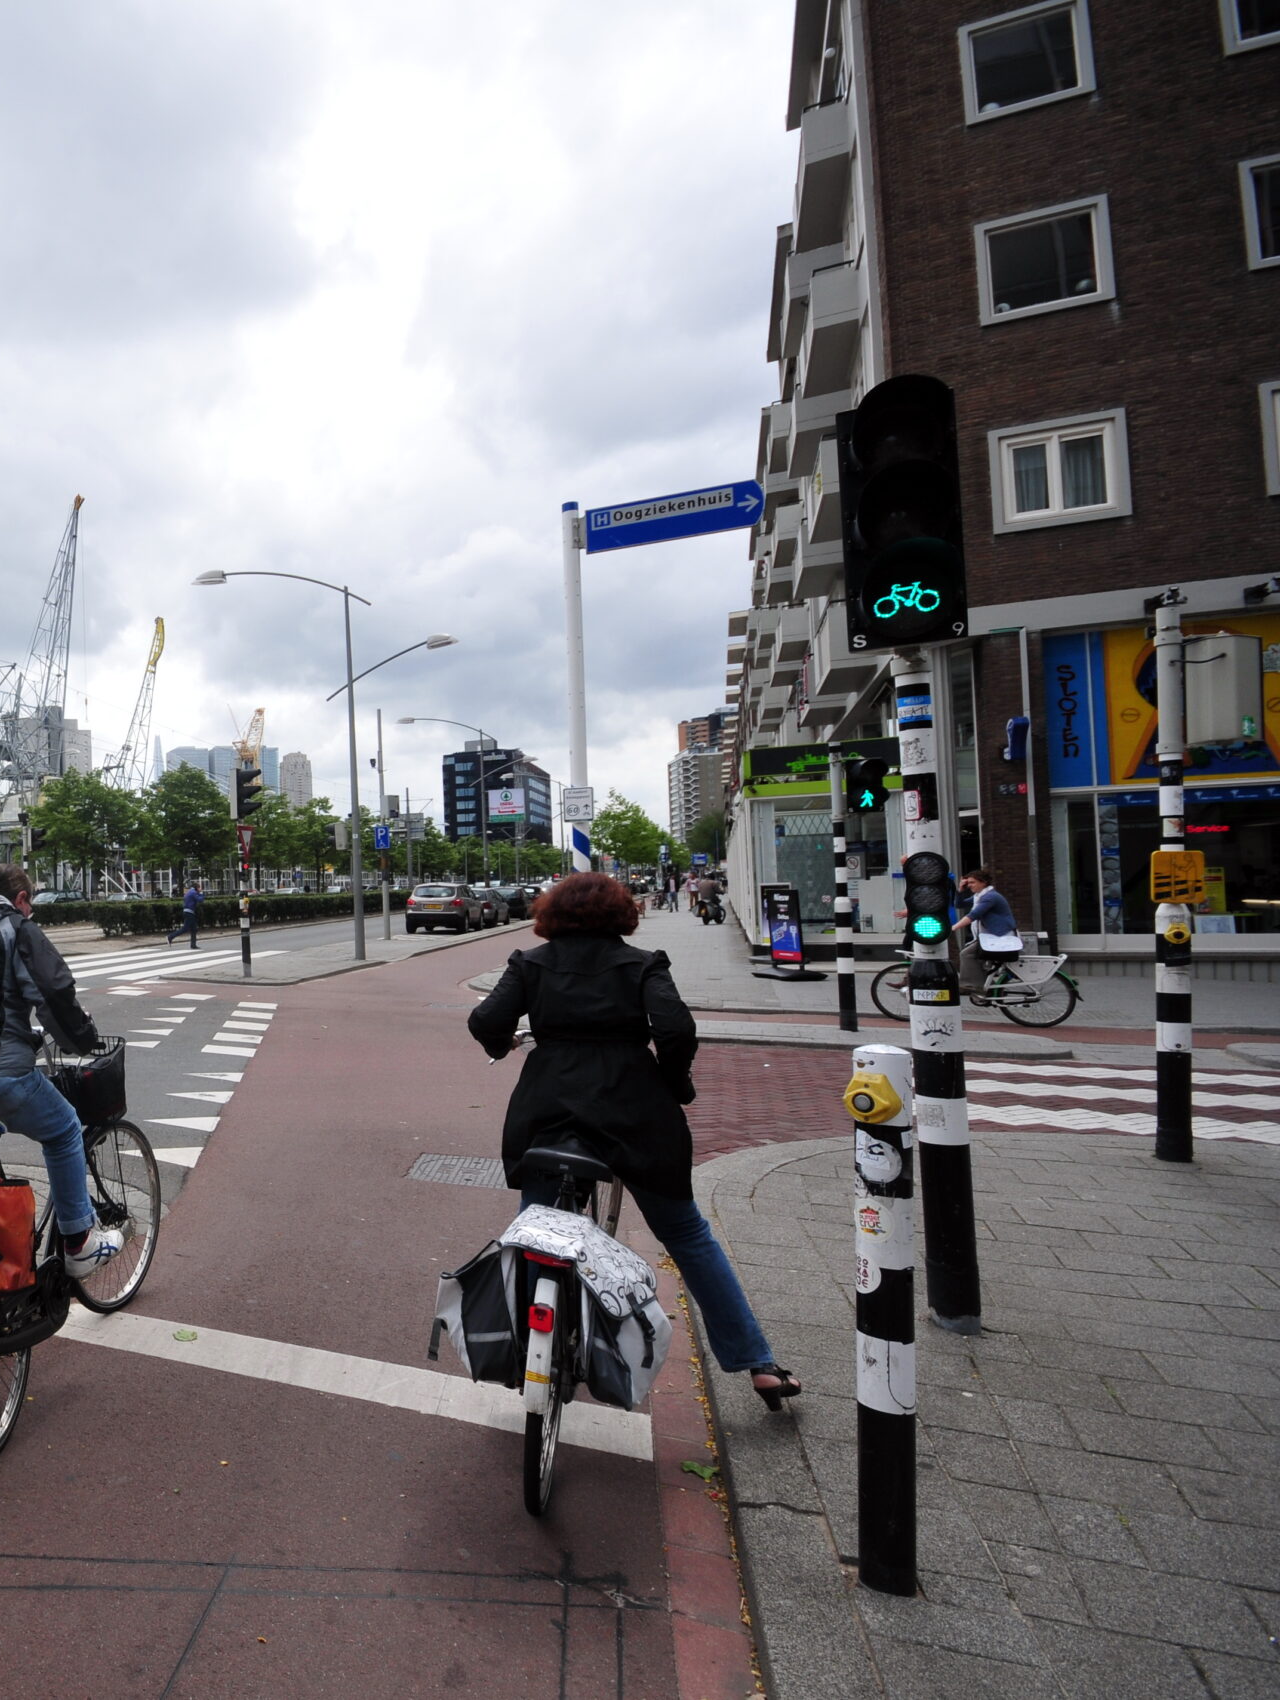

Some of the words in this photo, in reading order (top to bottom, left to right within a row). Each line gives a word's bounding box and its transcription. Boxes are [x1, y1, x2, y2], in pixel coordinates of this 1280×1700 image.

[613, 491, 732, 522] Oogziekenhuis
[951, 621, 965, 636] 9
[852, 634, 867, 648] S
[377, 828, 386, 840] P
[1185, 824, 1231, 834] Service
